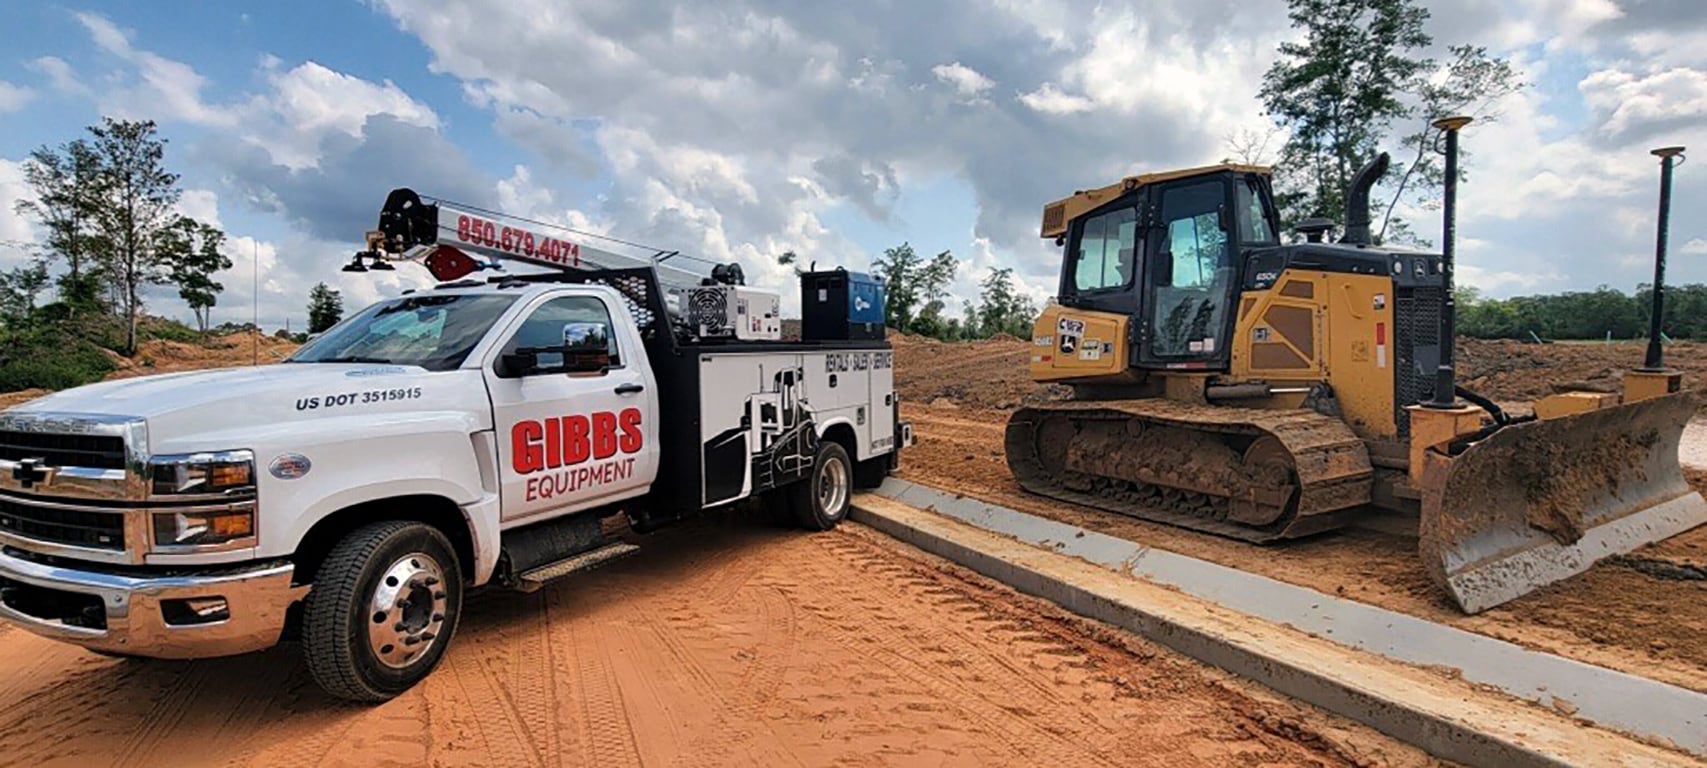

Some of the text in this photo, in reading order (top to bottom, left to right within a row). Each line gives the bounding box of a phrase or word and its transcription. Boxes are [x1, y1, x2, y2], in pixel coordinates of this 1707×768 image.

[457, 214, 580, 267] 850.679.4071
[853, 353, 868, 371] SALES
[296, 387, 422, 411] US DOT 3515915
[511, 407, 643, 475] GIBBS
[526, 458, 635, 501] EQUIPMENT
